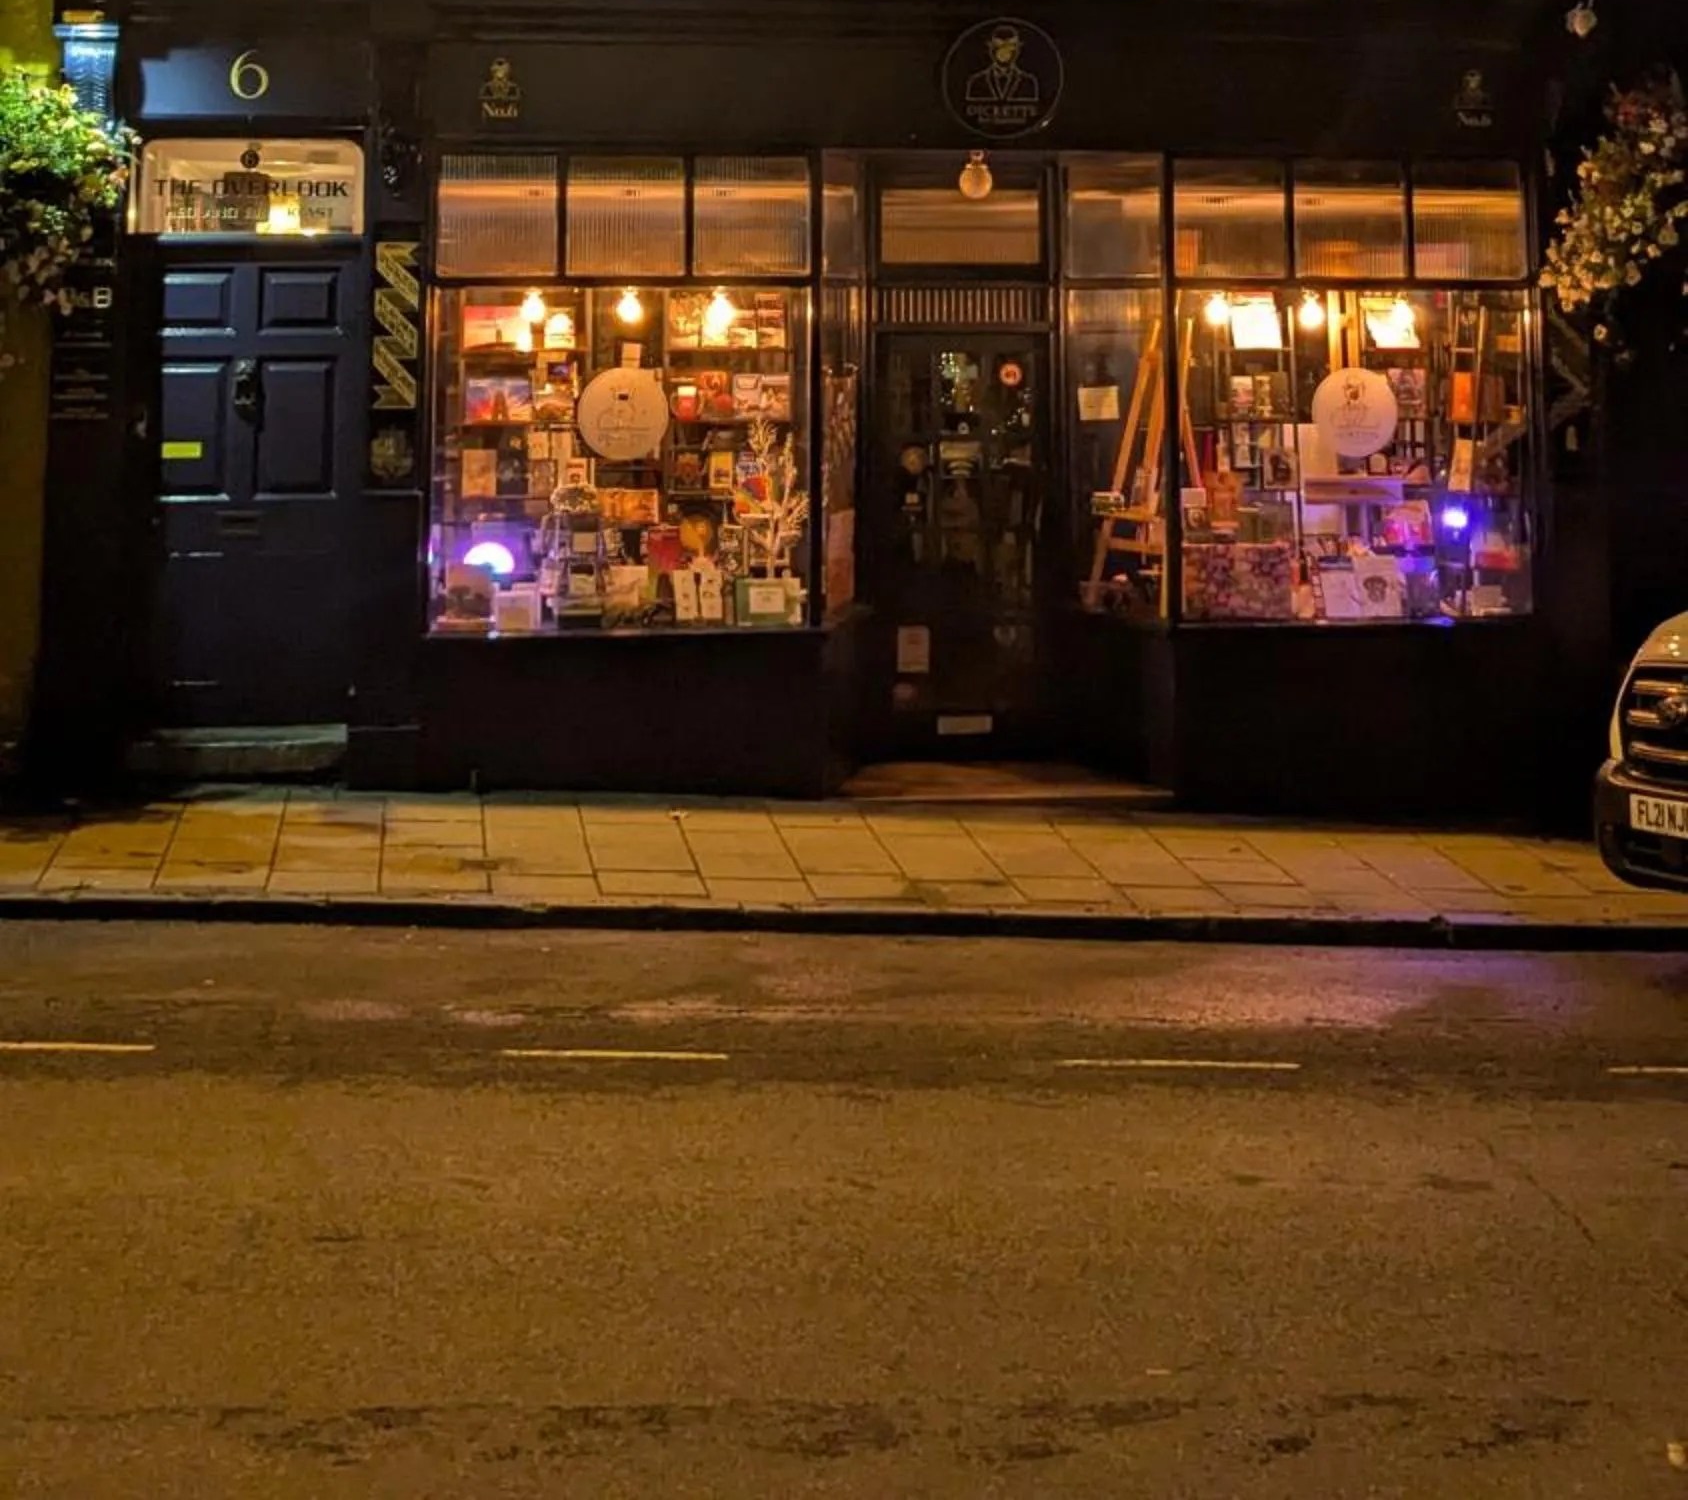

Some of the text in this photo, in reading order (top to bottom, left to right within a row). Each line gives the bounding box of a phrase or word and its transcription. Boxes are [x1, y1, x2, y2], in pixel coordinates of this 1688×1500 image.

[230, 50, 269, 100] 6
[154, 179, 349, 197] THE OVERLOOK
